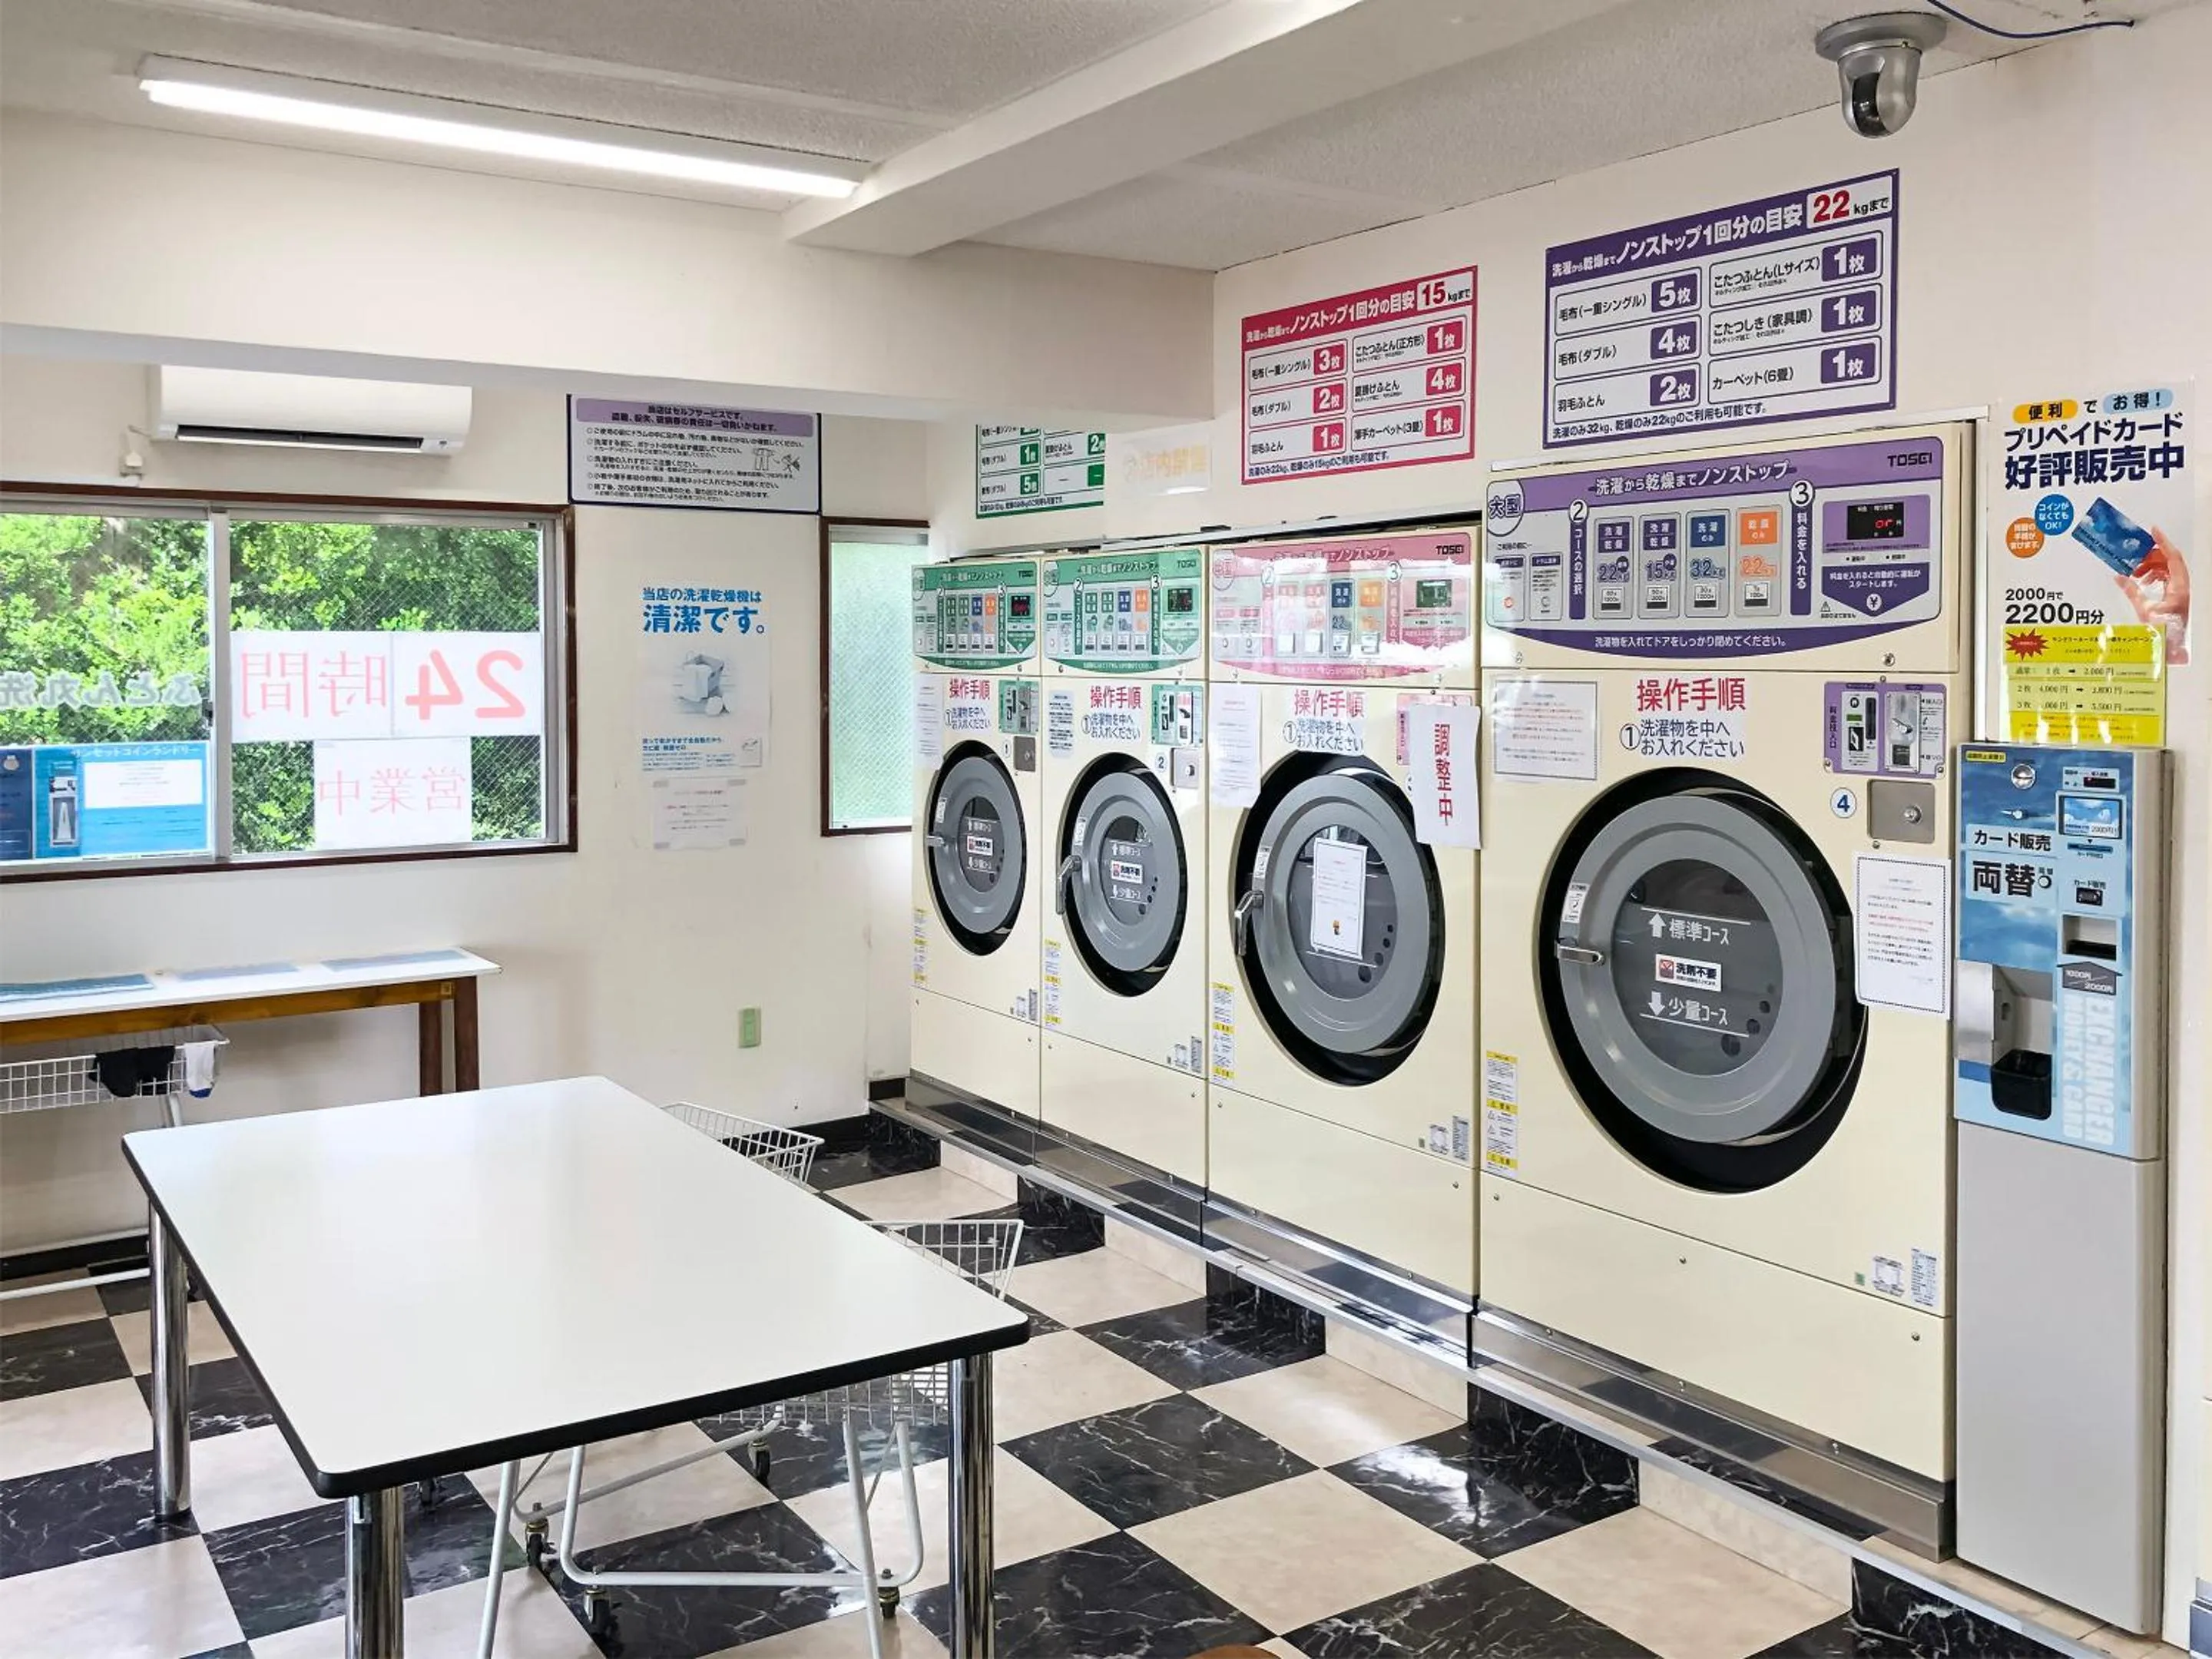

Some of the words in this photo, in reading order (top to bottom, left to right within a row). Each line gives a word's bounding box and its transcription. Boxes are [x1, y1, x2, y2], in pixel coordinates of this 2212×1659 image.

[1551, 204, 1803, 277] 洗濯から乾燥までノンストップ1回分の目安
[1714, 255, 1821, 289] こたつふとん(Lサイズ)
[1833, 245, 1865, 275] 1枚
[1558, 293, 1647, 321] 毛布(一重シングル)
[1659, 276, 1691, 306] 5枚
[1713, 309, 1813, 337] こたつしき(家具調)
[1833, 298, 1865, 326] 1枚
[1434, 326, 1455, 349] 1枚
[1558, 345, 1617, 366] 毛布(ダブル)
[1658, 327, 1691, 353] 4枚
[1319, 349, 1340, 371] 3枚
[1712, 366, 1795, 390] カーペット(6畳)
[1832, 351, 1864, 379] 1枚
[1431, 368, 1455, 390] 4枚
[1251, 400, 1291, 417] 毛布(ダブル)
[1319, 388, 1340, 409] 2枚
[1557, 394, 1605, 413] 羽毛ふとん
[1659, 375, 1691, 402] 2枚
[2028, 402, 2064, 420] 便利
[2084, 400, 2098, 414] で
[2112, 391, 2161, 411] お得!
[1432, 410, 1454, 433] 1枚
[2005, 412, 2184, 452] プリペイドカード
[1251, 442, 1284, 455] 羽毛ふとん
[1320, 427, 1340, 448] 1枚
[1887, 452, 1932, 468] TOSEI
[2005, 442, 2185, 491] 好評販売中
[1594, 461, 1790, 497] 洗濯から乾燥までノンストップ
[1794, 482, 1810, 505] 3
[1488, 495, 1522, 518] 大型
[1573, 502, 1584, 520] 2
[2038, 502, 2069, 512] コインが
[2038, 512, 2069, 522] なくても
[1573, 528, 1584, 596] コースの選択
[1796, 512, 1808, 590] 料金を入れる
[642, 588, 762, 603] 当店の洗濯乾燥機は
[2005, 588, 2064, 601] 2000円で
[642, 604, 766, 634] 清潔です。
[2005, 602, 2104, 625] 2200円分
[1594, 634, 1787, 650] 洗濯物を入れてドアをしっかり閉めてください。
[949, 678, 991, 700] 操作手順
[1090, 686, 1143, 710] 操作手順
[1636, 677, 1746, 713] 操作手順
[1293, 689, 1365, 718] 操作手順
[951, 717, 992, 730] お入れください
[1089, 713, 1134, 727] 洗濯物を中へ
[1640, 718, 1730, 737] 洗濯物を中へ
[1090, 726, 1141, 740] お入れください
[1296, 735, 1363, 752] お入れください
[1640, 737, 1745, 757] お入れください
[1433, 723, 1453, 826] 調整中
[1836, 794, 1850, 812] 4
[1974, 830, 2051, 852] カード販売
[1972, 860, 2036, 898] 両替
[2074, 879, 2107, 889] カード販売
[1669, 917, 1730, 945] 標準コース
[1675, 962, 1717, 980] 洗剤不要
[1668, 997, 1728, 1026] 少量コース
[2085, 995, 2115, 1146] EXCHANGER
